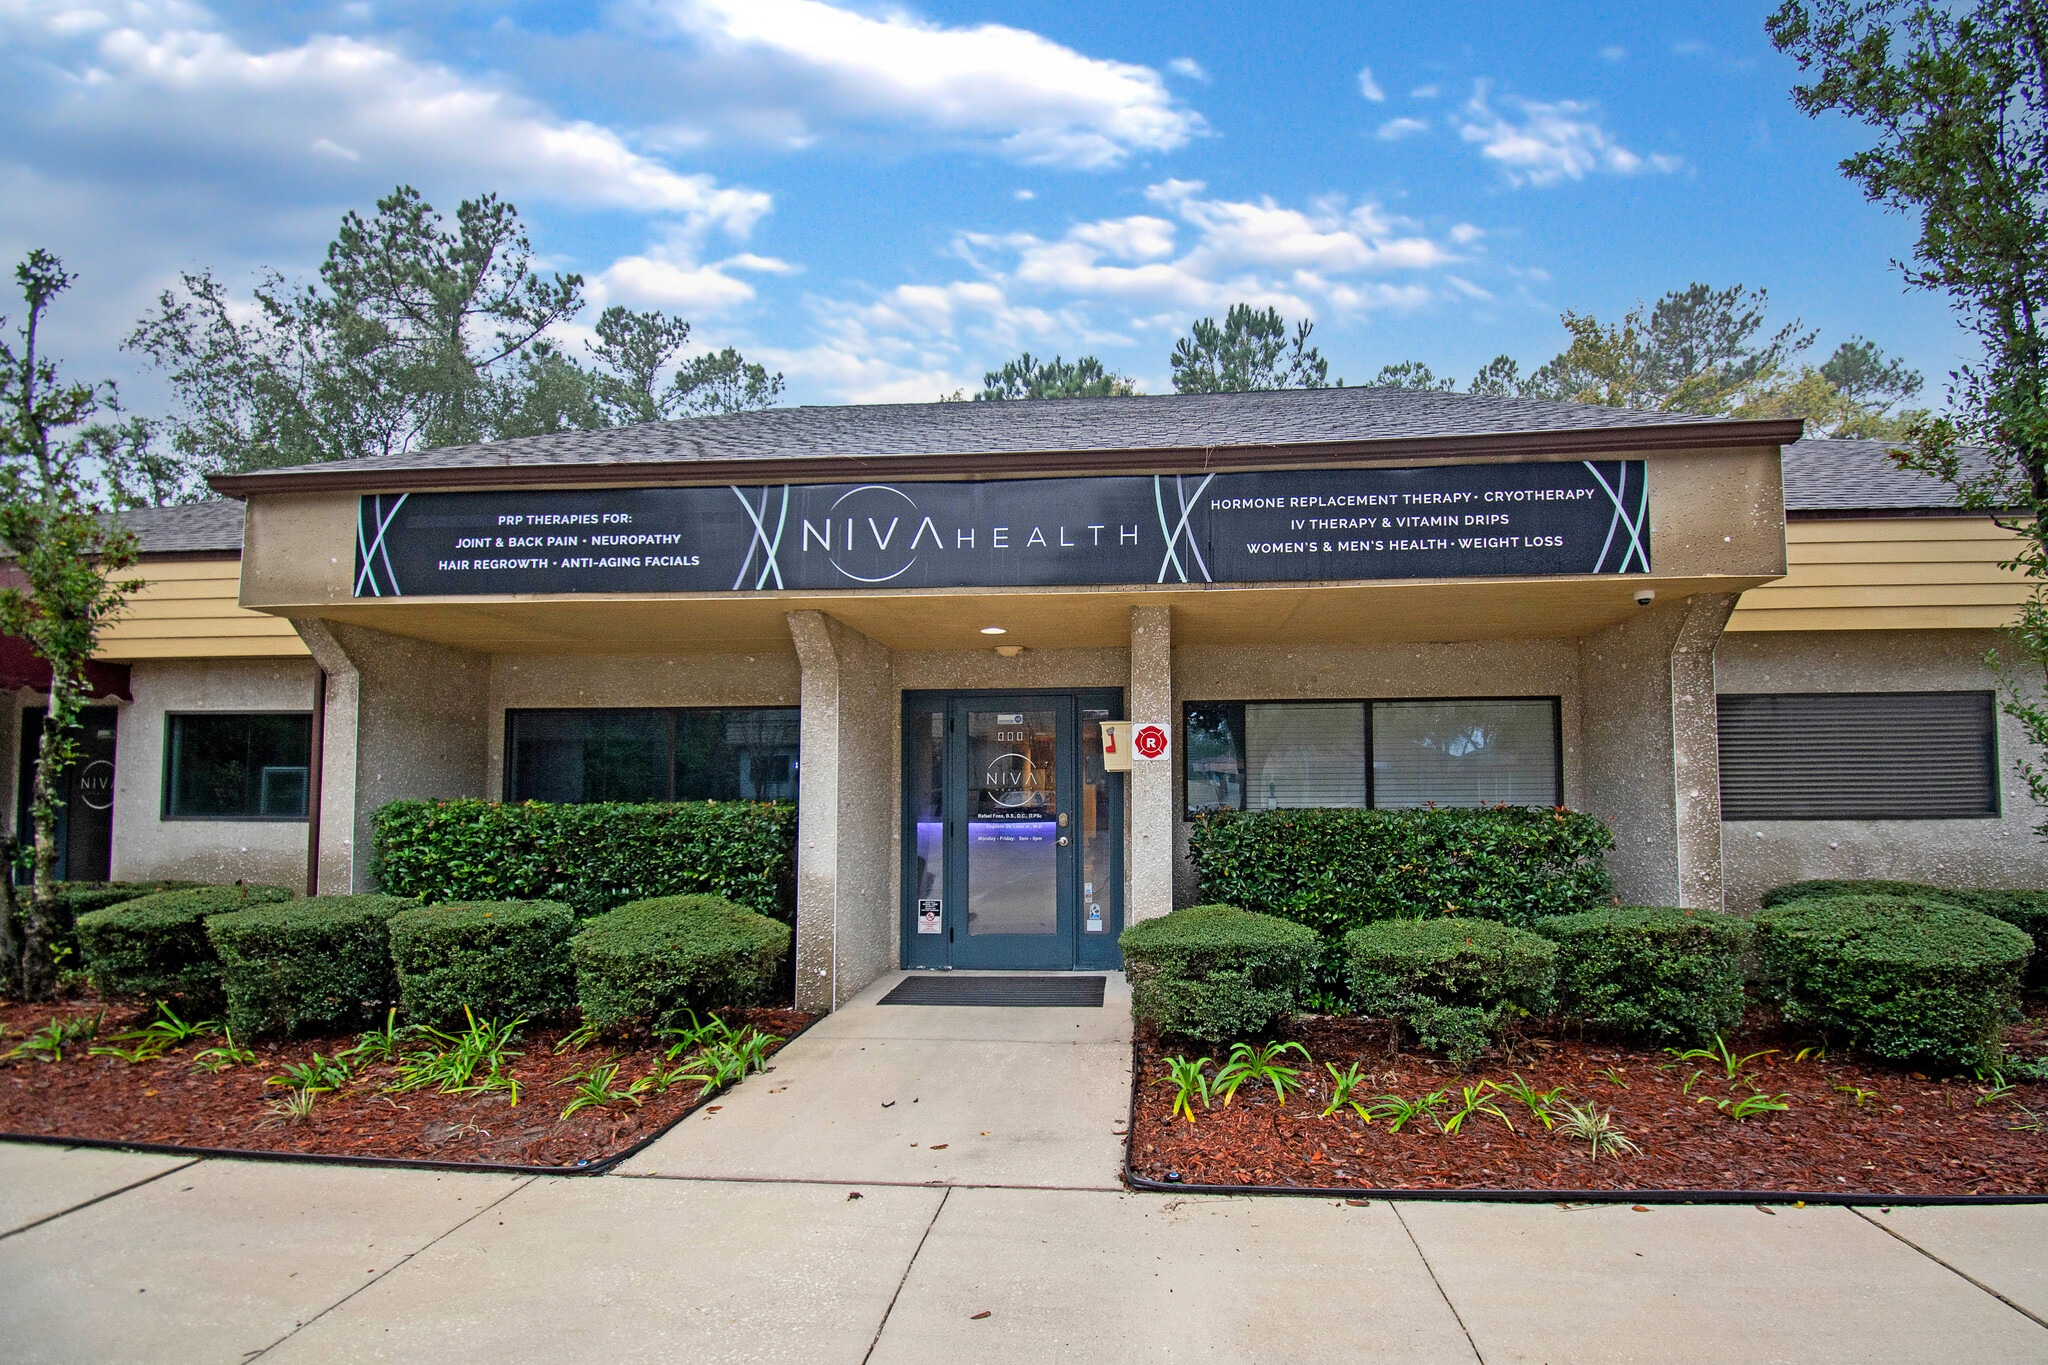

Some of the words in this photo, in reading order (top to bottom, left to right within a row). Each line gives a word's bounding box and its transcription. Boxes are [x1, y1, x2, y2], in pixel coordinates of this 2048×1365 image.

[1211, 497, 1285, 510] HORMONE
[1290, 494, 1398, 508] REPLACEMENT
[1402, 492, 1472, 505] THERAPY
[1484, 488, 1595, 502] CRYOTHERAPY
[498, 515, 523, 525] PRP
[526, 514, 599, 525] THERAPIES
[602, 513, 633, 524] FOR:
[1291, 519, 1305, 530] IV
[1309, 517, 1378, 530] THERAPY
[1381, 517, 1392, 528] &
[1396, 515, 1459, 528] VITAMIN
[1464, 514, 1510, 526] DRIPS
[455, 537, 492, 549] JOINT
[495, 537, 504, 548] &
[508, 536, 544, 547] BACK
[547, 536, 578, 547] PAIN
[591, 534, 682, 546] NEUROPATHY
[803, 516, 943, 551] NIVA
[957, 525, 1138, 548] HEALTH
[1246, 541, 1318, 554] WOMEN'S
[1322, 541, 1333, 552] &
[1337, 540, 1384, 552] MEN'S
[1389, 538, 1448, 551] HEALTH
[1458, 536, 1520, 549] WEIGHT
[1524, 536, 1564, 548] LOSS
[439, 560, 470, 571] HAIR
[473, 558, 548, 570] REGROWTH
[561, 557, 641, 568] ANTI-AGING
[644, 555, 700, 567] FACIALS
[1146, 737, 1157, 748] R
[986, 772, 1037, 785] NIVA
